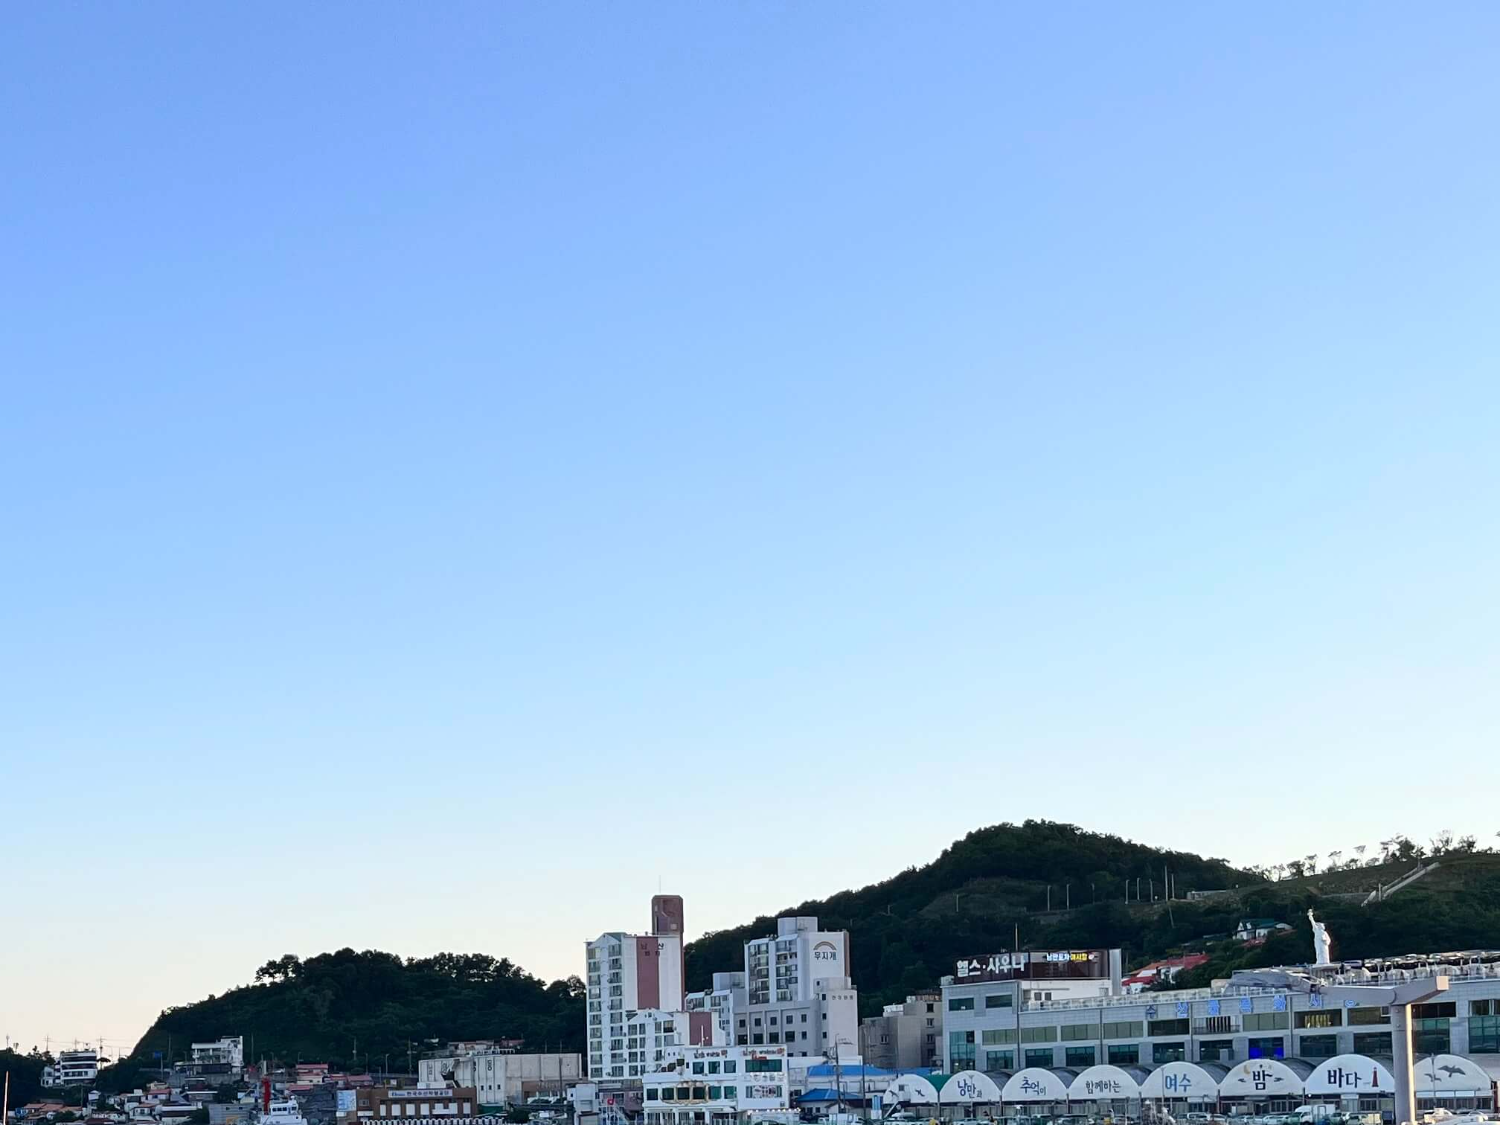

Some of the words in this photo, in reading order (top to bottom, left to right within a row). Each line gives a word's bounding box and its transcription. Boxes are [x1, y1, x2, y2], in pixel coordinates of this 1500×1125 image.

[814, 951, 837, 961] 무지개
[956, 955, 1025, 977] 헬스·사우나
[957, 1079, 983, 1098] 낭만과
[1019, 1076, 1047, 1095] 추억이
[1085, 1079, 1122, 1094] 함께하는
[1164, 1073, 1192, 1092] 여수
[1252, 1069, 1273, 1090] 밤
[1327, 1067, 1362, 1088] 바다
